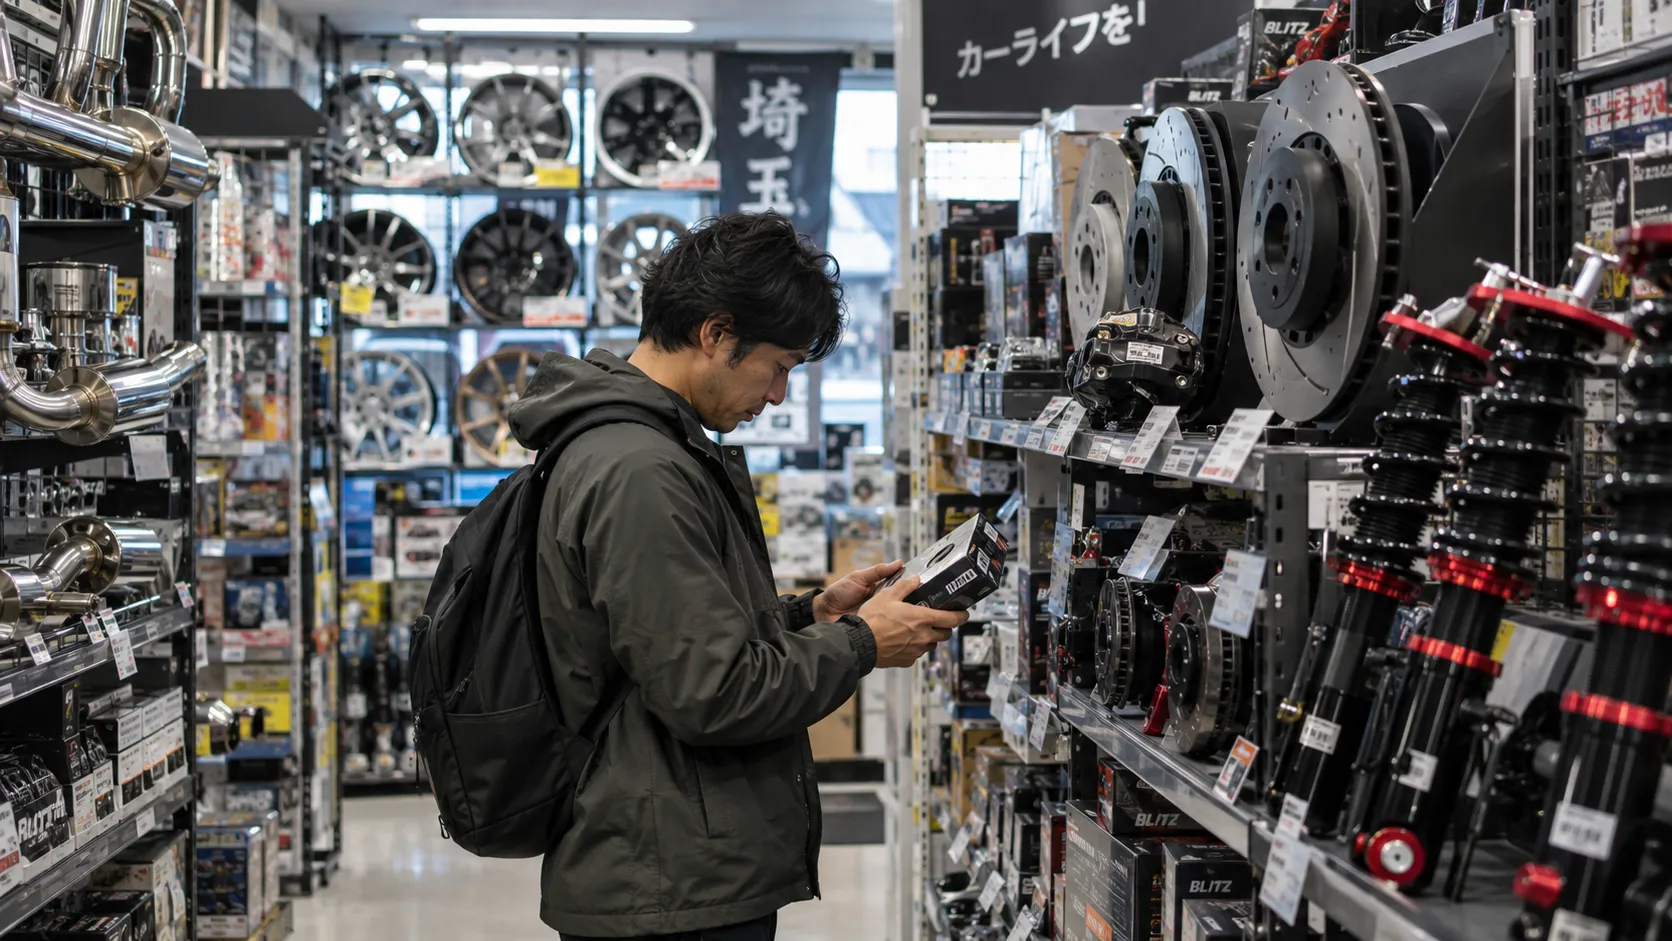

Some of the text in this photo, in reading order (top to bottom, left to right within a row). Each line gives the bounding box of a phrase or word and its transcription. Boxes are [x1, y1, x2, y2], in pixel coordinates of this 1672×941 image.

[1264, 21, 1311, 35] BLITZ
[1188, 90, 1221, 102] BLITZ
[738, 76, 809, 217] 埼玉
[1135, 813, 1180, 827] BLITZ
[1189, 880, 1233, 893] BLITZ
